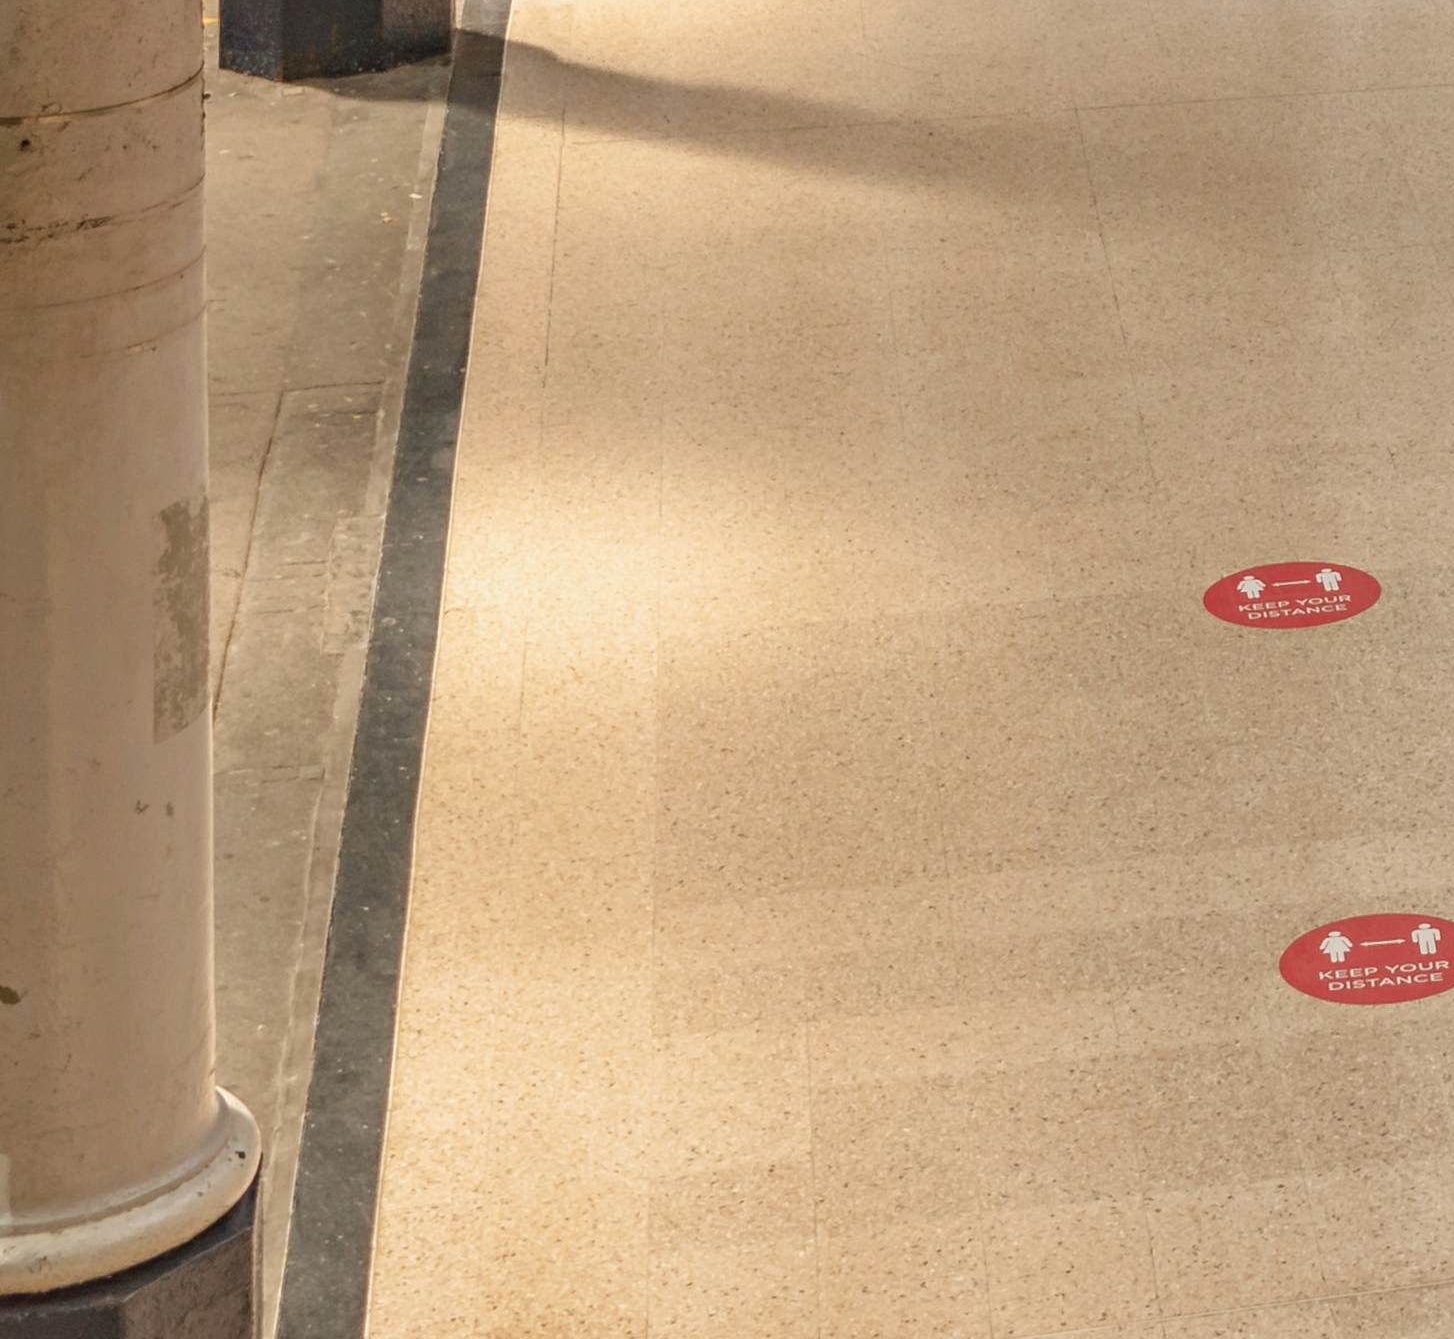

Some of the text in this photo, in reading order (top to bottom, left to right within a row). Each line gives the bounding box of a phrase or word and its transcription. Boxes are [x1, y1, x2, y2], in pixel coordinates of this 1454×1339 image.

[1238, 594, 1352, 613] KEEP YOUR
[1248, 603, 1347, 620] DISTANCE
[1319, 961, 1449, 980] KEEP YOUR
[1328, 972, 1443, 992] DISTANCE
